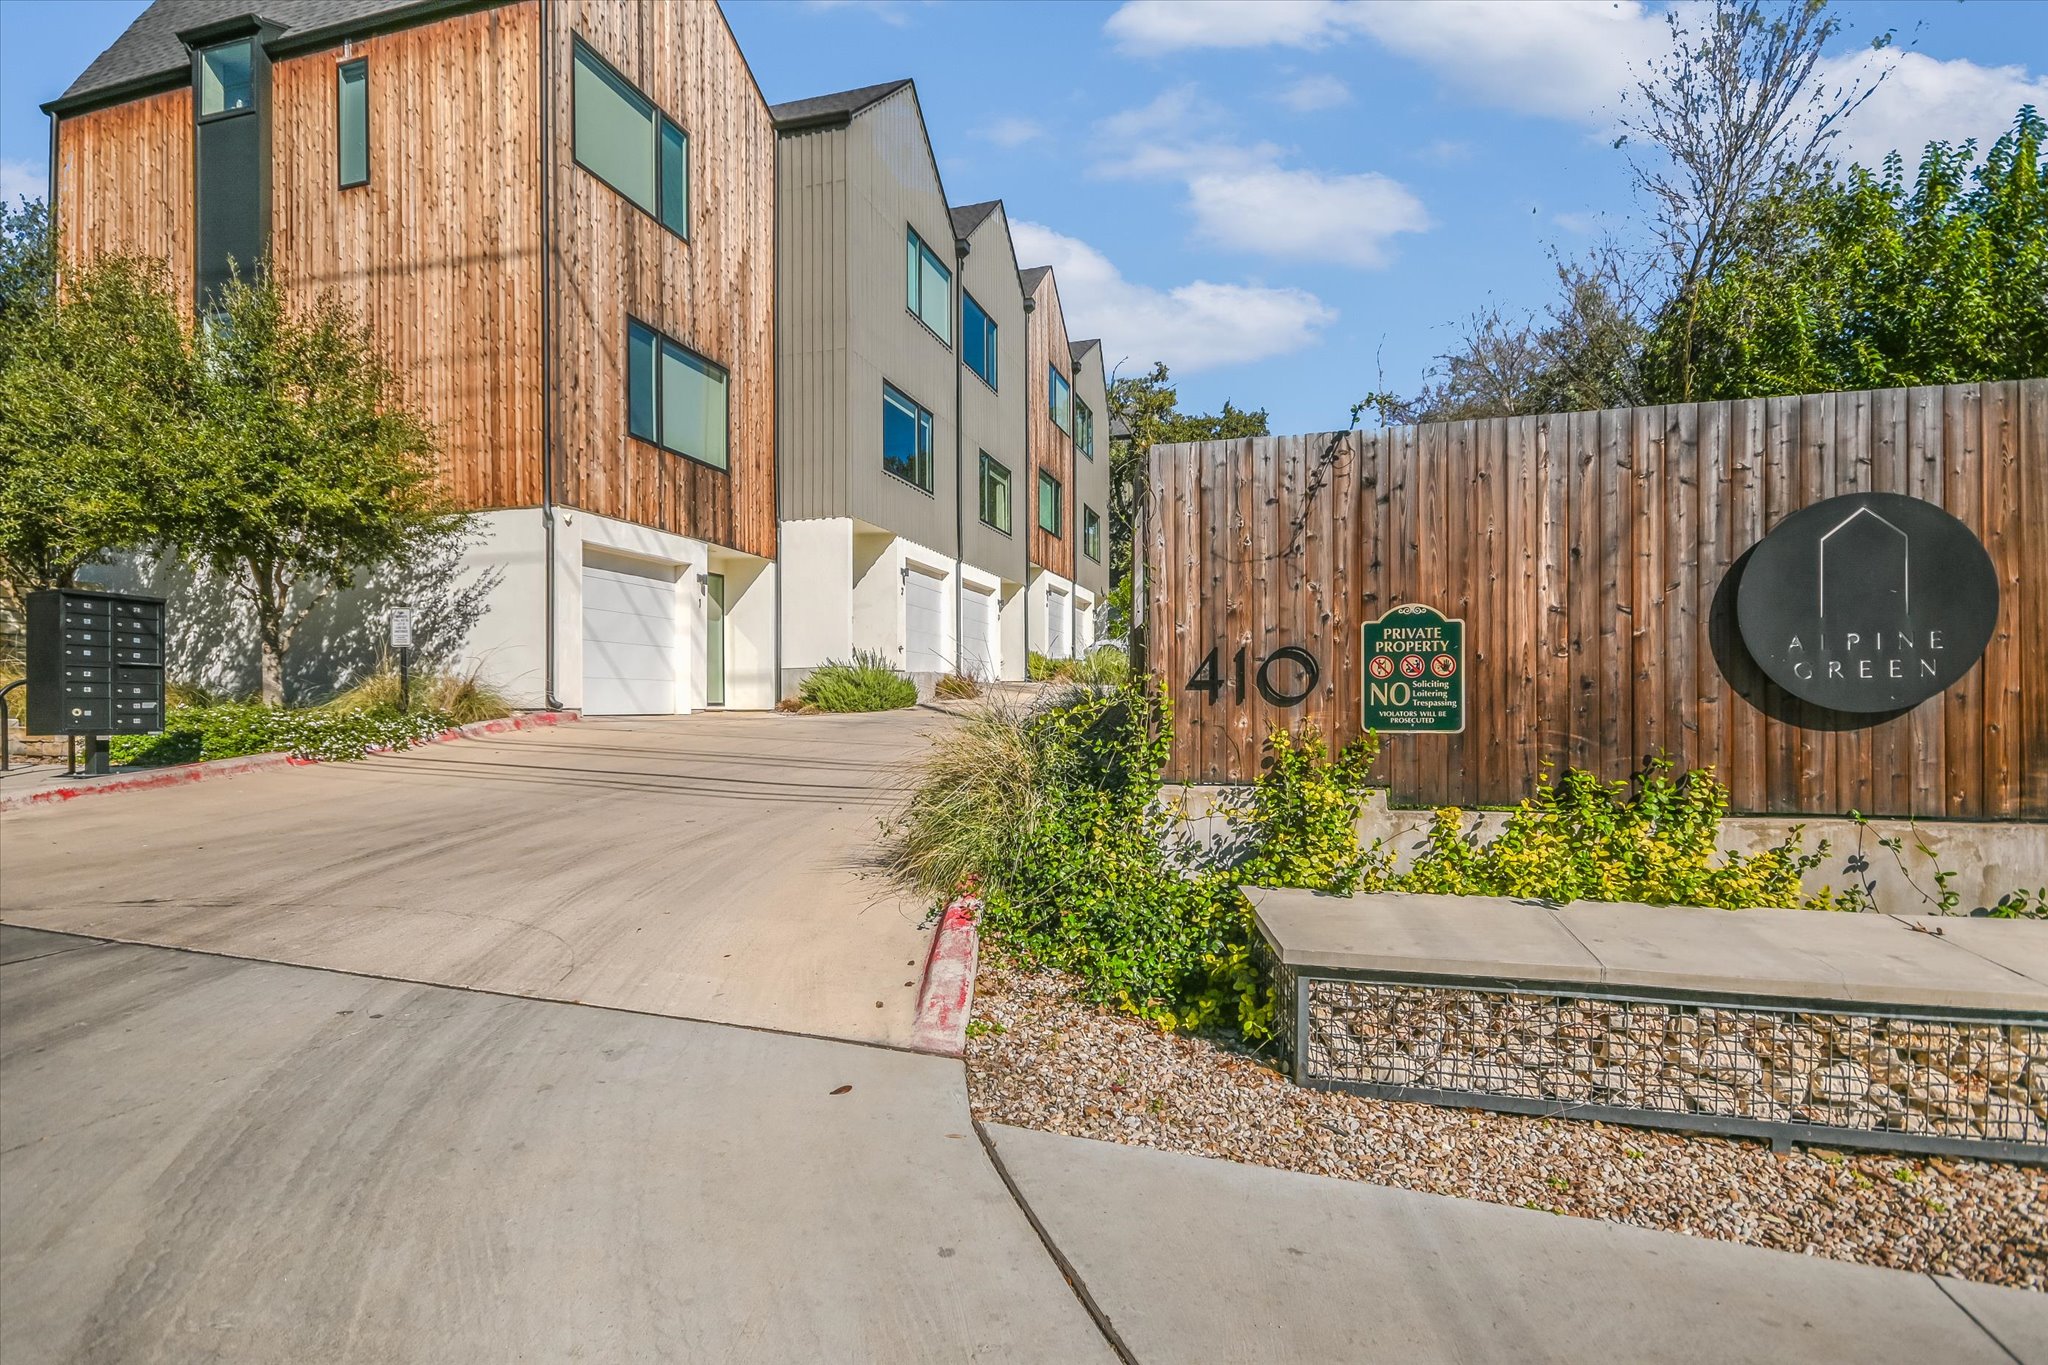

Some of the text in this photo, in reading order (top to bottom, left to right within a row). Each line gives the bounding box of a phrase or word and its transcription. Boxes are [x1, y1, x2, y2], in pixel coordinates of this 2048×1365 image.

[1383, 627, 1442, 639] PRIVATE
[1375, 640, 1450, 653] PROPERTY
[1793, 658, 1937, 680] GREEN
[1184, 645, 1320, 708] 410
[1412, 680, 1450, 690] Soliciting
[1370, 682, 1411, 706] NO
[1412, 689, 1448, 699] Loitering
[1412, 699, 1458, 708] Trespassing
